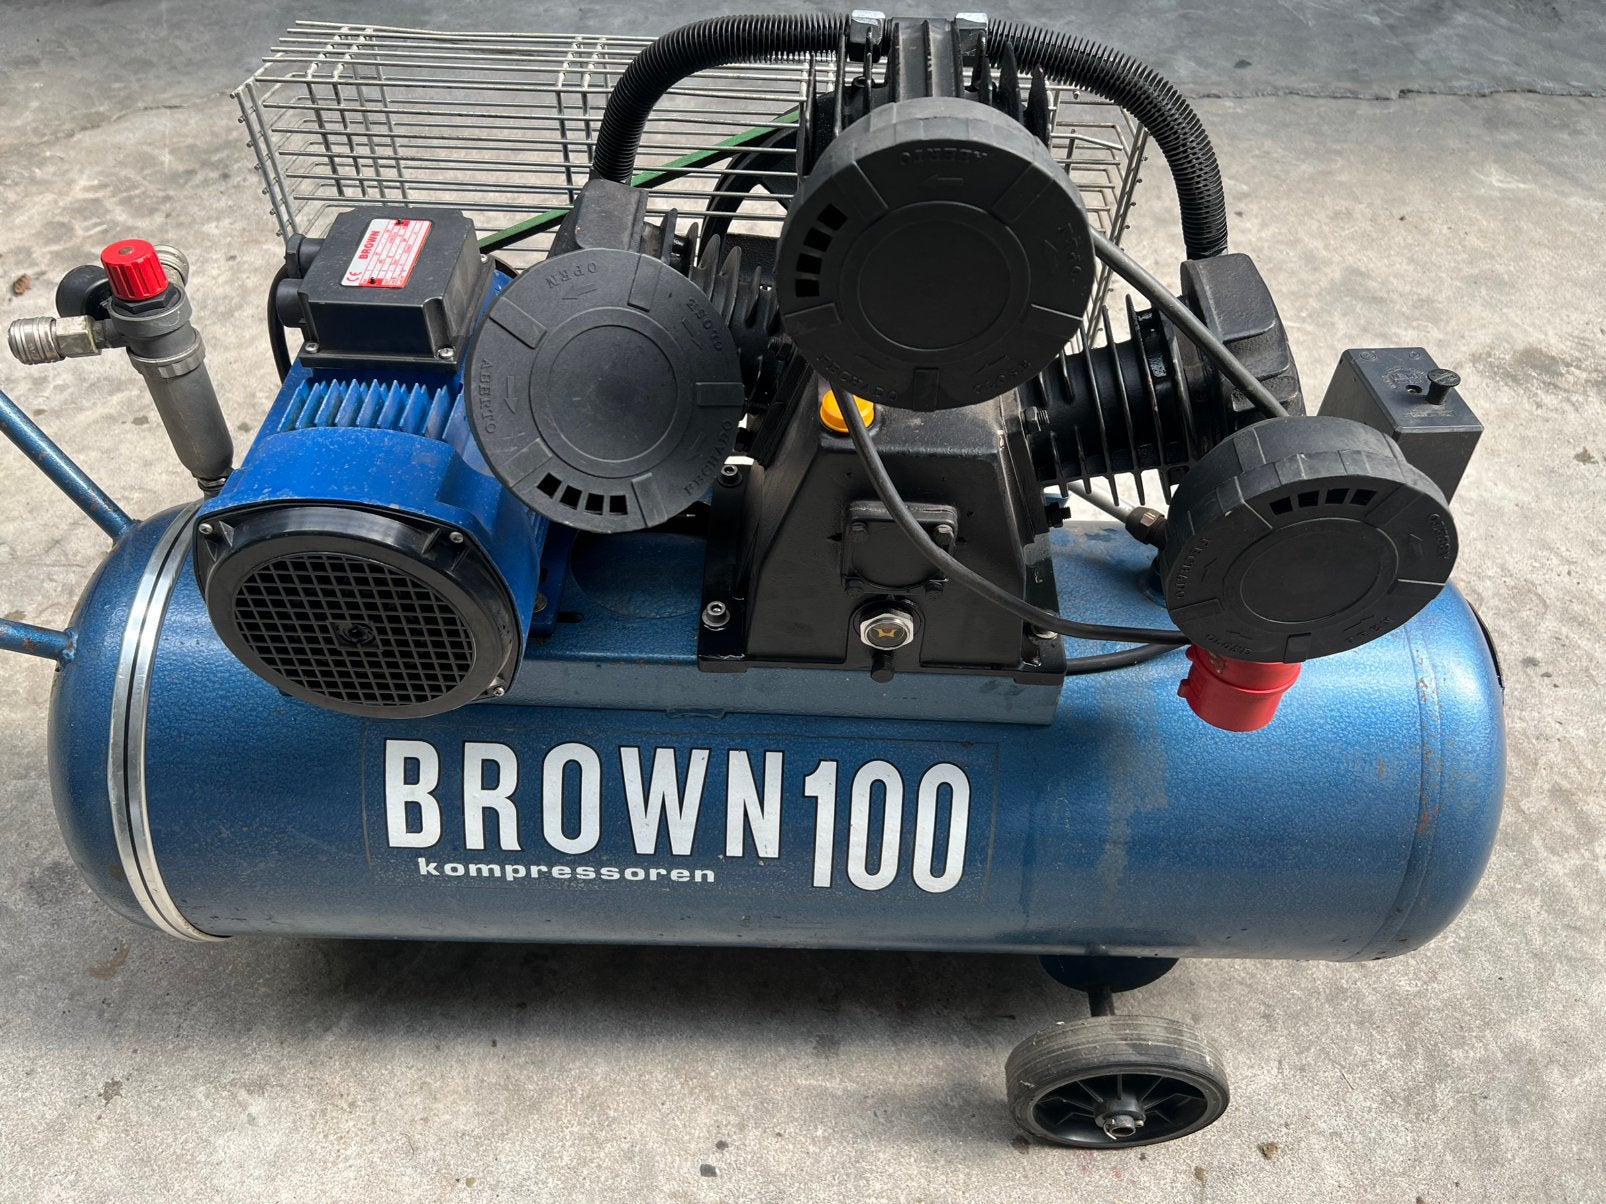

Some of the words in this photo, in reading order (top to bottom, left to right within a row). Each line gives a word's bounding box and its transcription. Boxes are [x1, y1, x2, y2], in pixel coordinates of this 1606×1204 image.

[358, 230, 381, 260] BROWN
[478, 358, 497, 435] ABERTO
[385, 738, 784, 859] BROWN
[803, 760, 971, 893] 100
[418, 857, 715, 884] kompressoren
